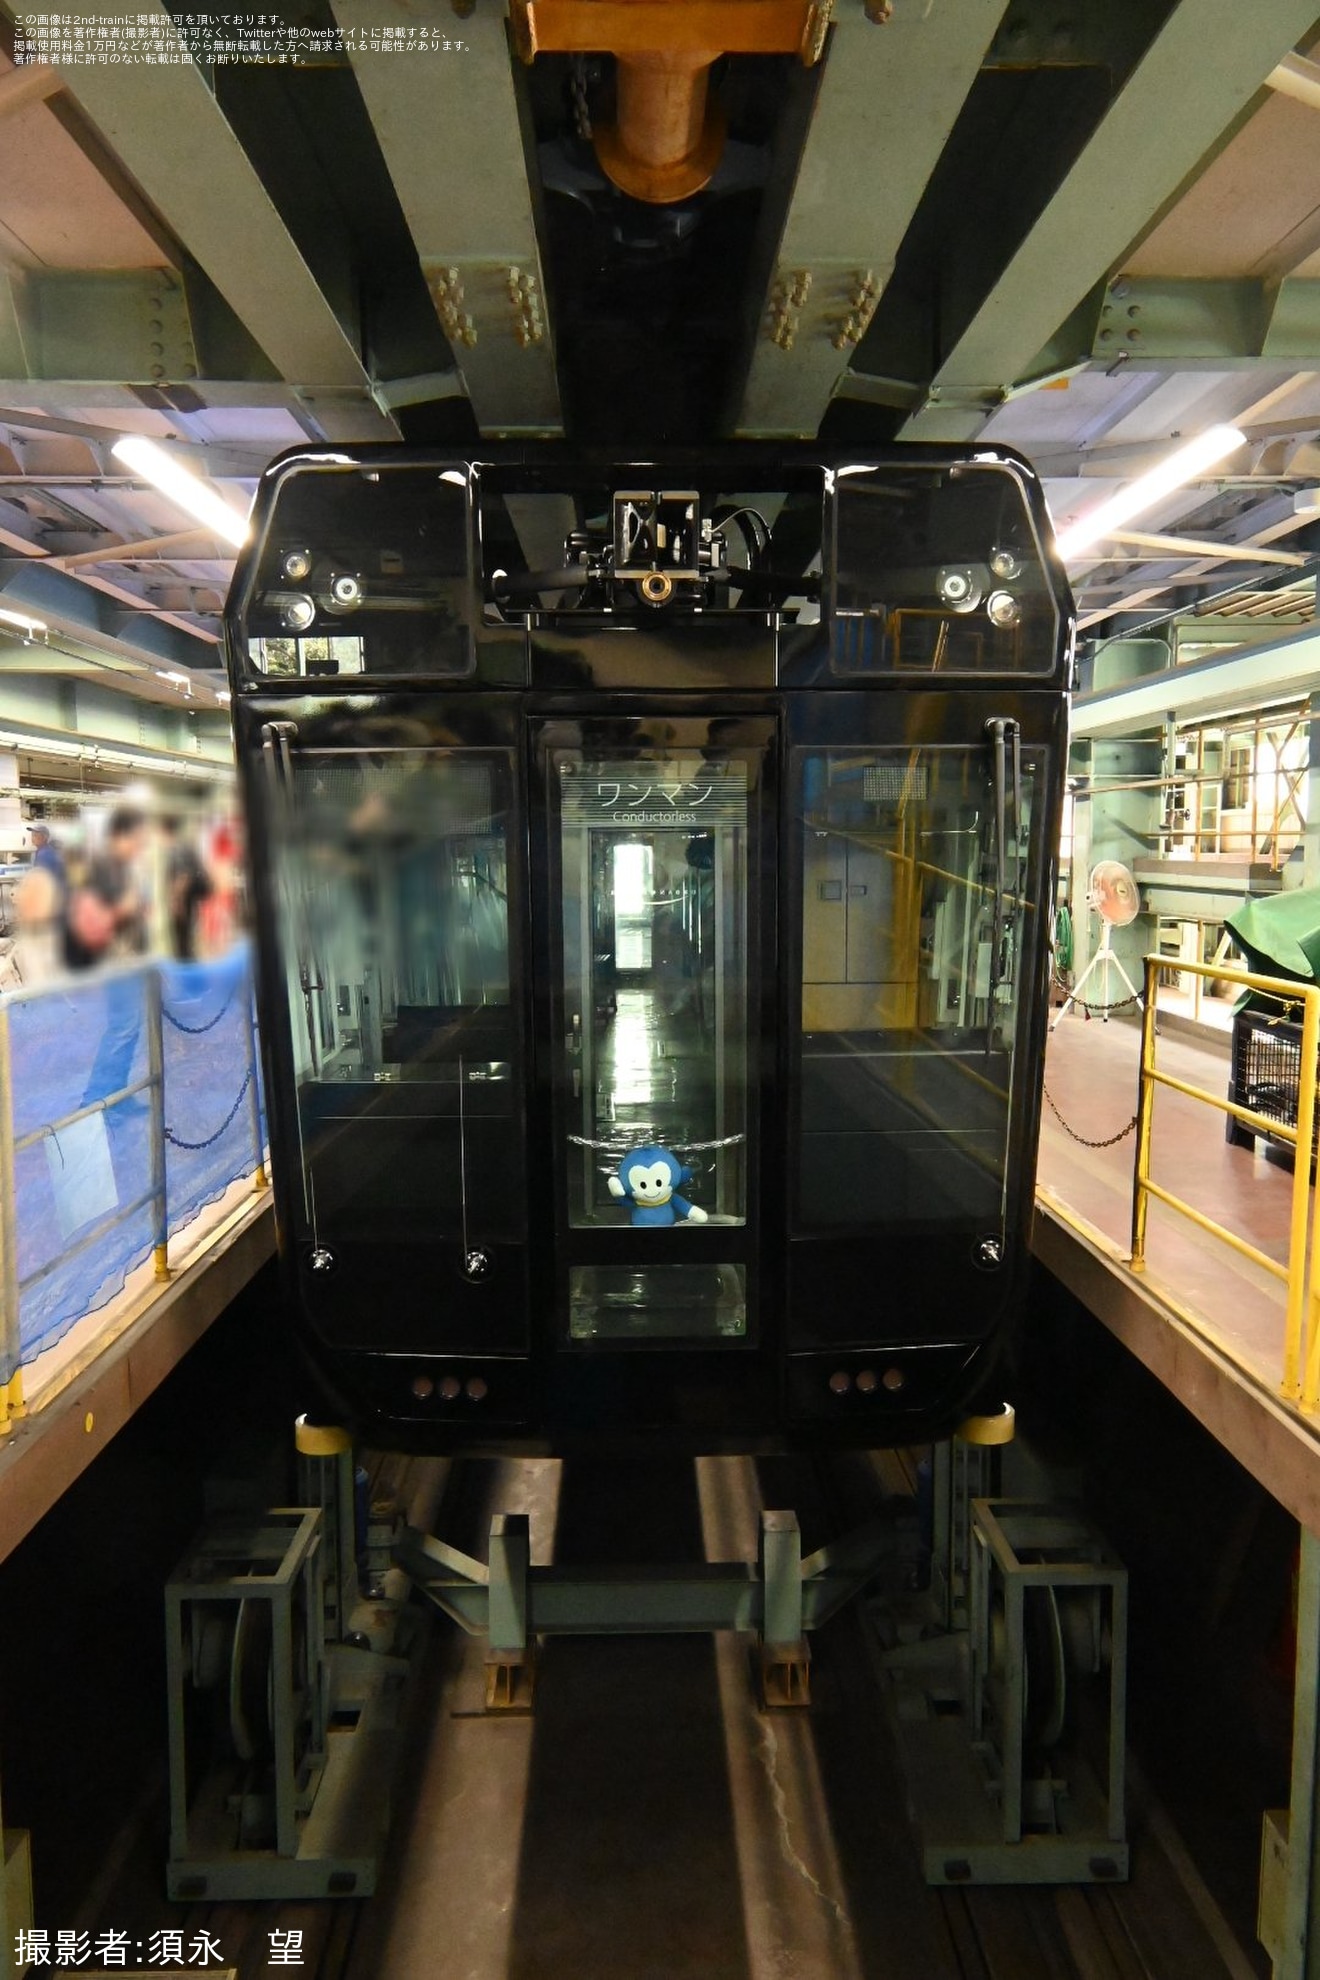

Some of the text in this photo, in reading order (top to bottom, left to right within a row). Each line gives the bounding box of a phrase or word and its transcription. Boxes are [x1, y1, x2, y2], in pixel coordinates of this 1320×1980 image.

[597, 783, 713, 807] ワンマン
[612, 810, 697, 823] Conductorless
